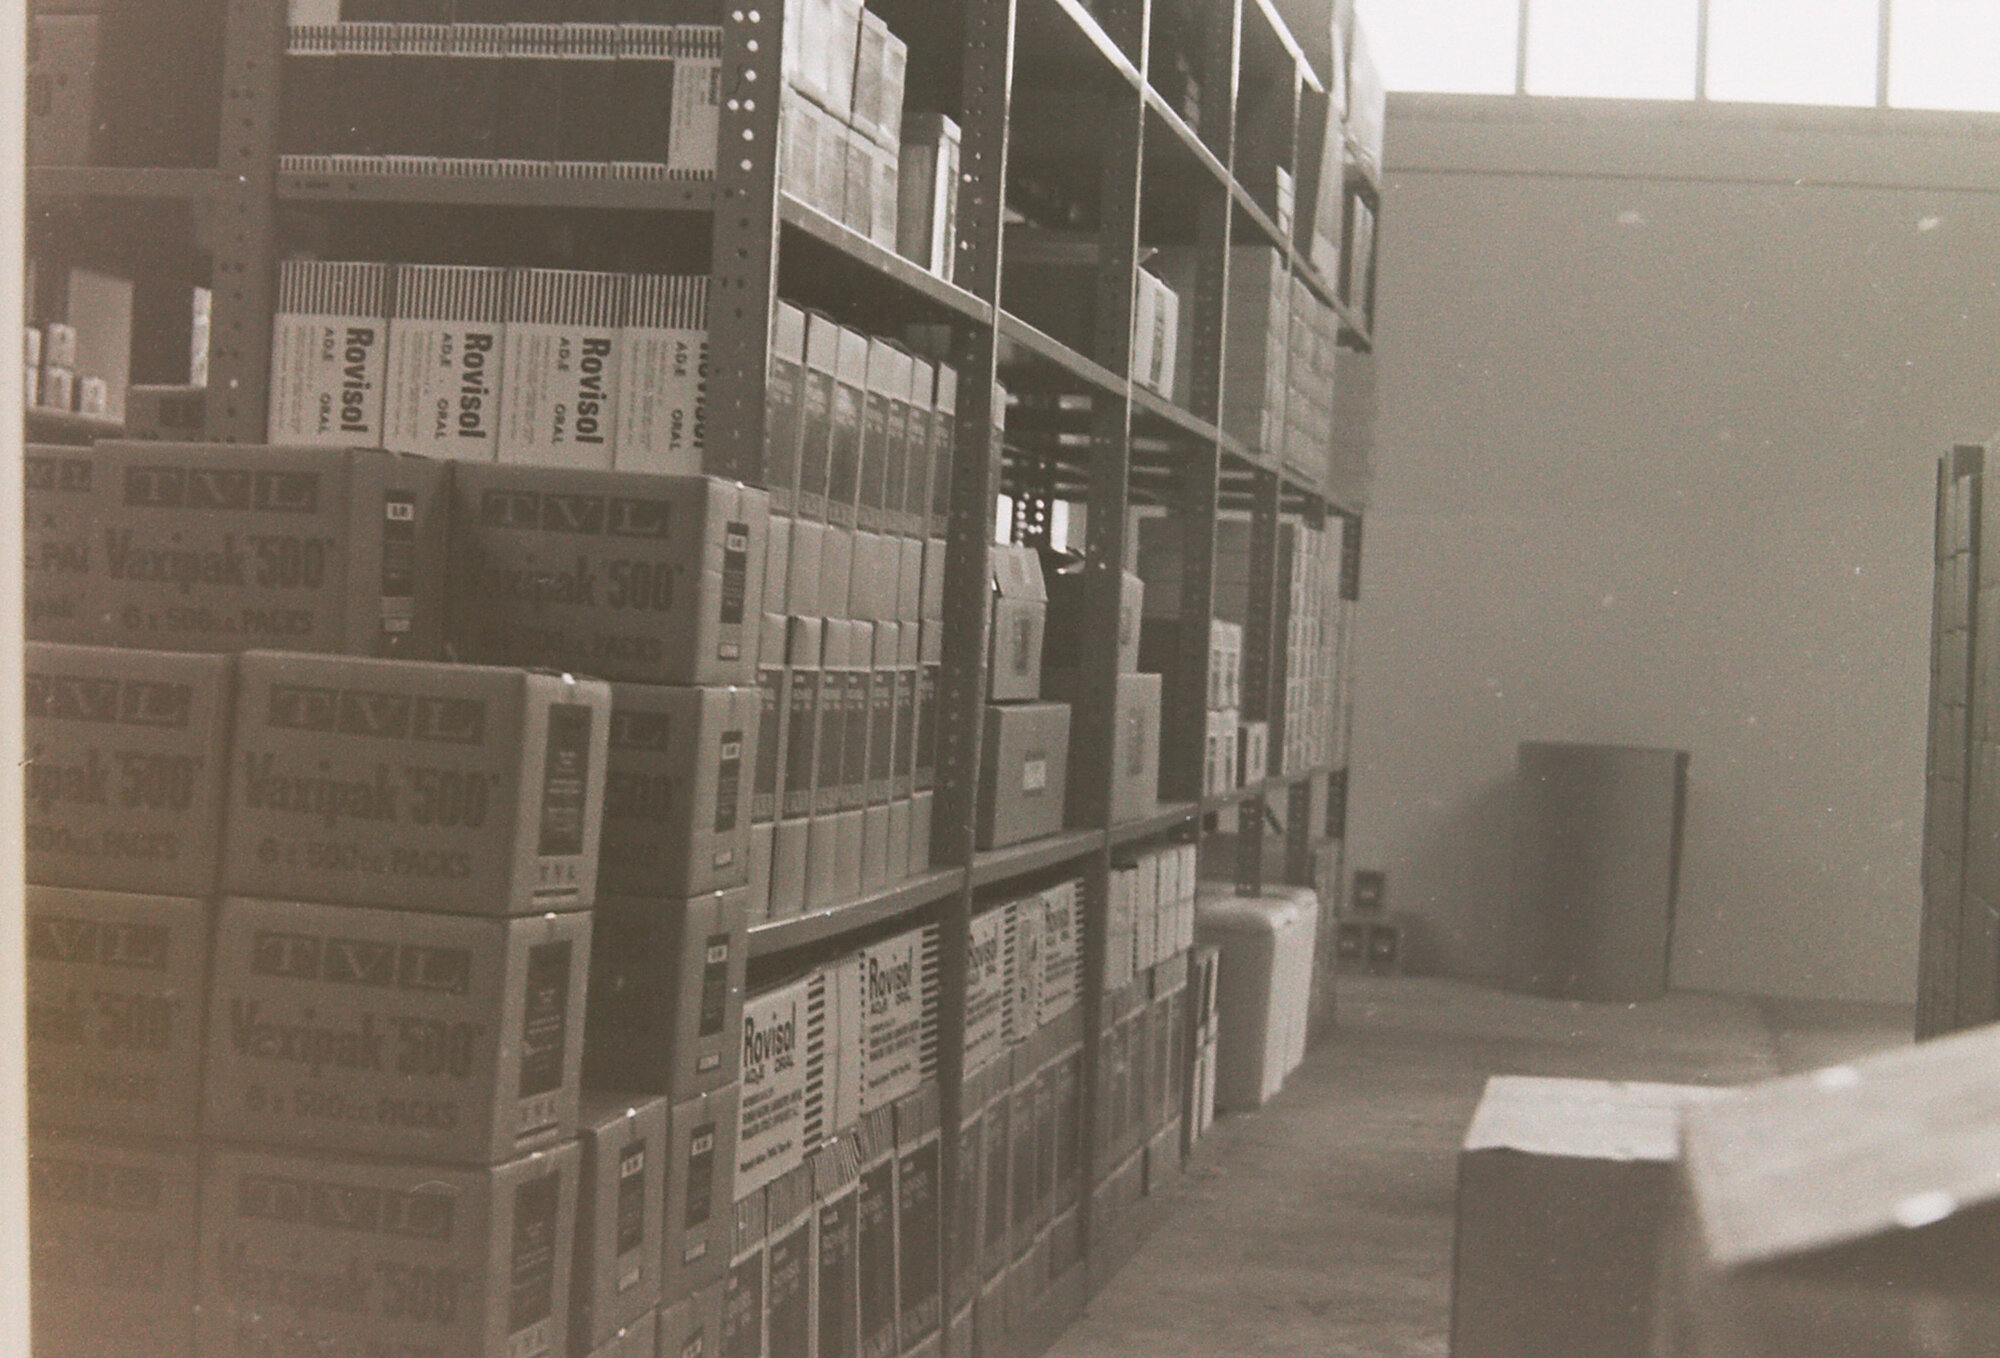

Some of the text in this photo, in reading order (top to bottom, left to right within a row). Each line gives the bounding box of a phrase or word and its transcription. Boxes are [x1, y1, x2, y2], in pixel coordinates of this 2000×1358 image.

[341, 328, 374, 432] Rovisol
[458, 333, 492, 437] Rovisol
[575, 338, 611, 444] Rovisol
[316, 392, 332, 435] ORAL
[433, 397, 450, 441] ORAL
[551, 403, 567, 446] ORAL
[668, 408, 684, 452] ORAL
[128, 469, 314, 508] TVL
[488, 495, 662, 532] TVL
[105, 528, 246, 595] Vaxipak
[276, 690, 476, 738] TVL
[245, 751, 399, 829] Vaxipak
[262, 938, 461, 986] TVL
[231, 999, 385, 1078] Vaxipak
[744, 1001, 796, 1067] Rovisol
